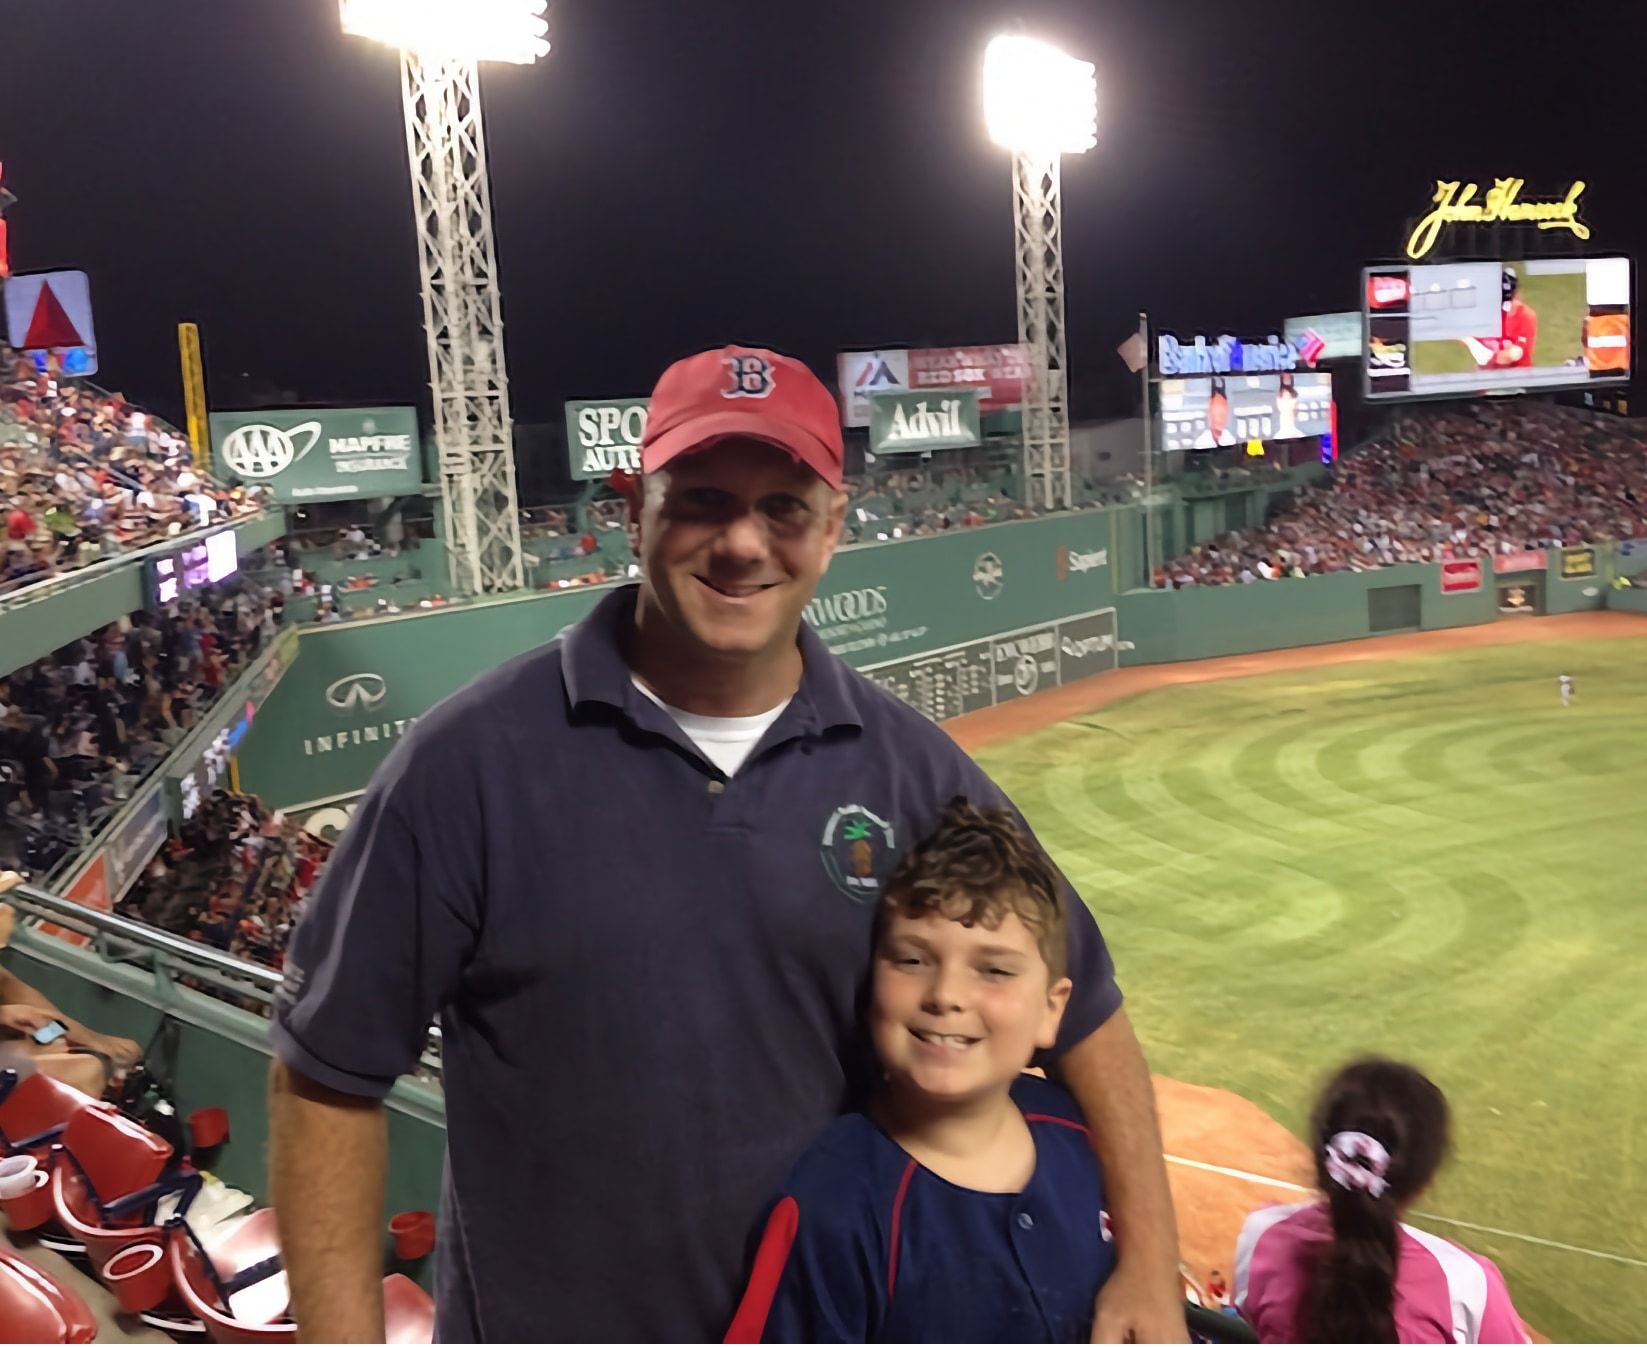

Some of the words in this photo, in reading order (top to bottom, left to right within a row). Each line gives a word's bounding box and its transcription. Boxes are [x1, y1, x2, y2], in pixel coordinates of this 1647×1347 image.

[720, 356, 776, 399] B
[887, 399, 961, 441] Advil
[304, 717, 419, 755] INFINIT
